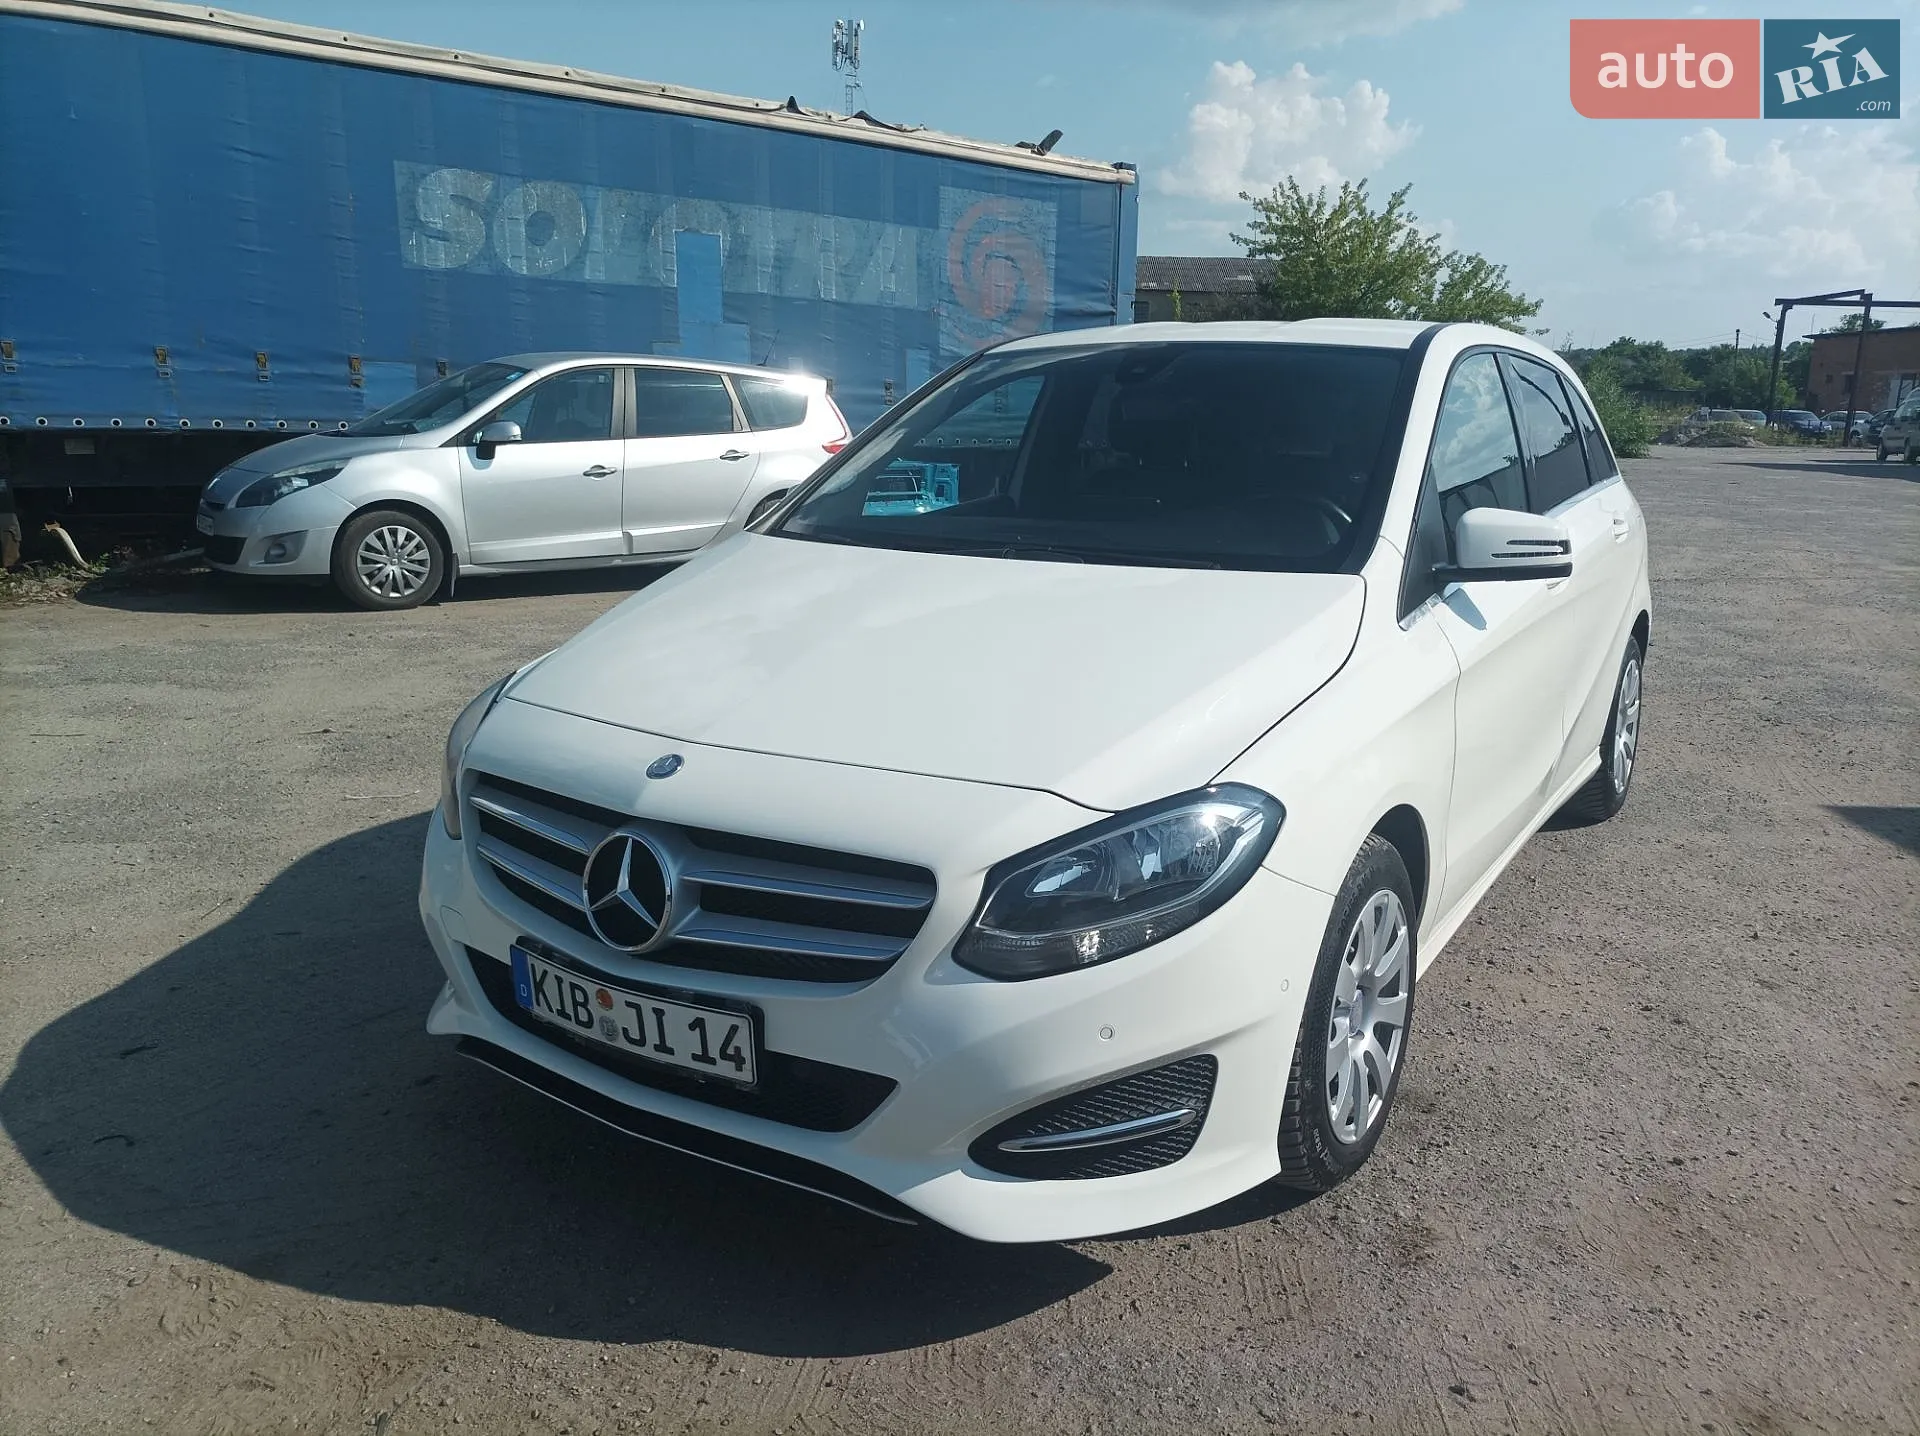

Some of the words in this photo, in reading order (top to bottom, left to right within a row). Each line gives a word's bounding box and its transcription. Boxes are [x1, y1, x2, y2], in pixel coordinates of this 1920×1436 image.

[530, 962, 595, 1030] KIB
[622, 1000, 675, 1056] JI
[688, 1016, 747, 1072] 14
